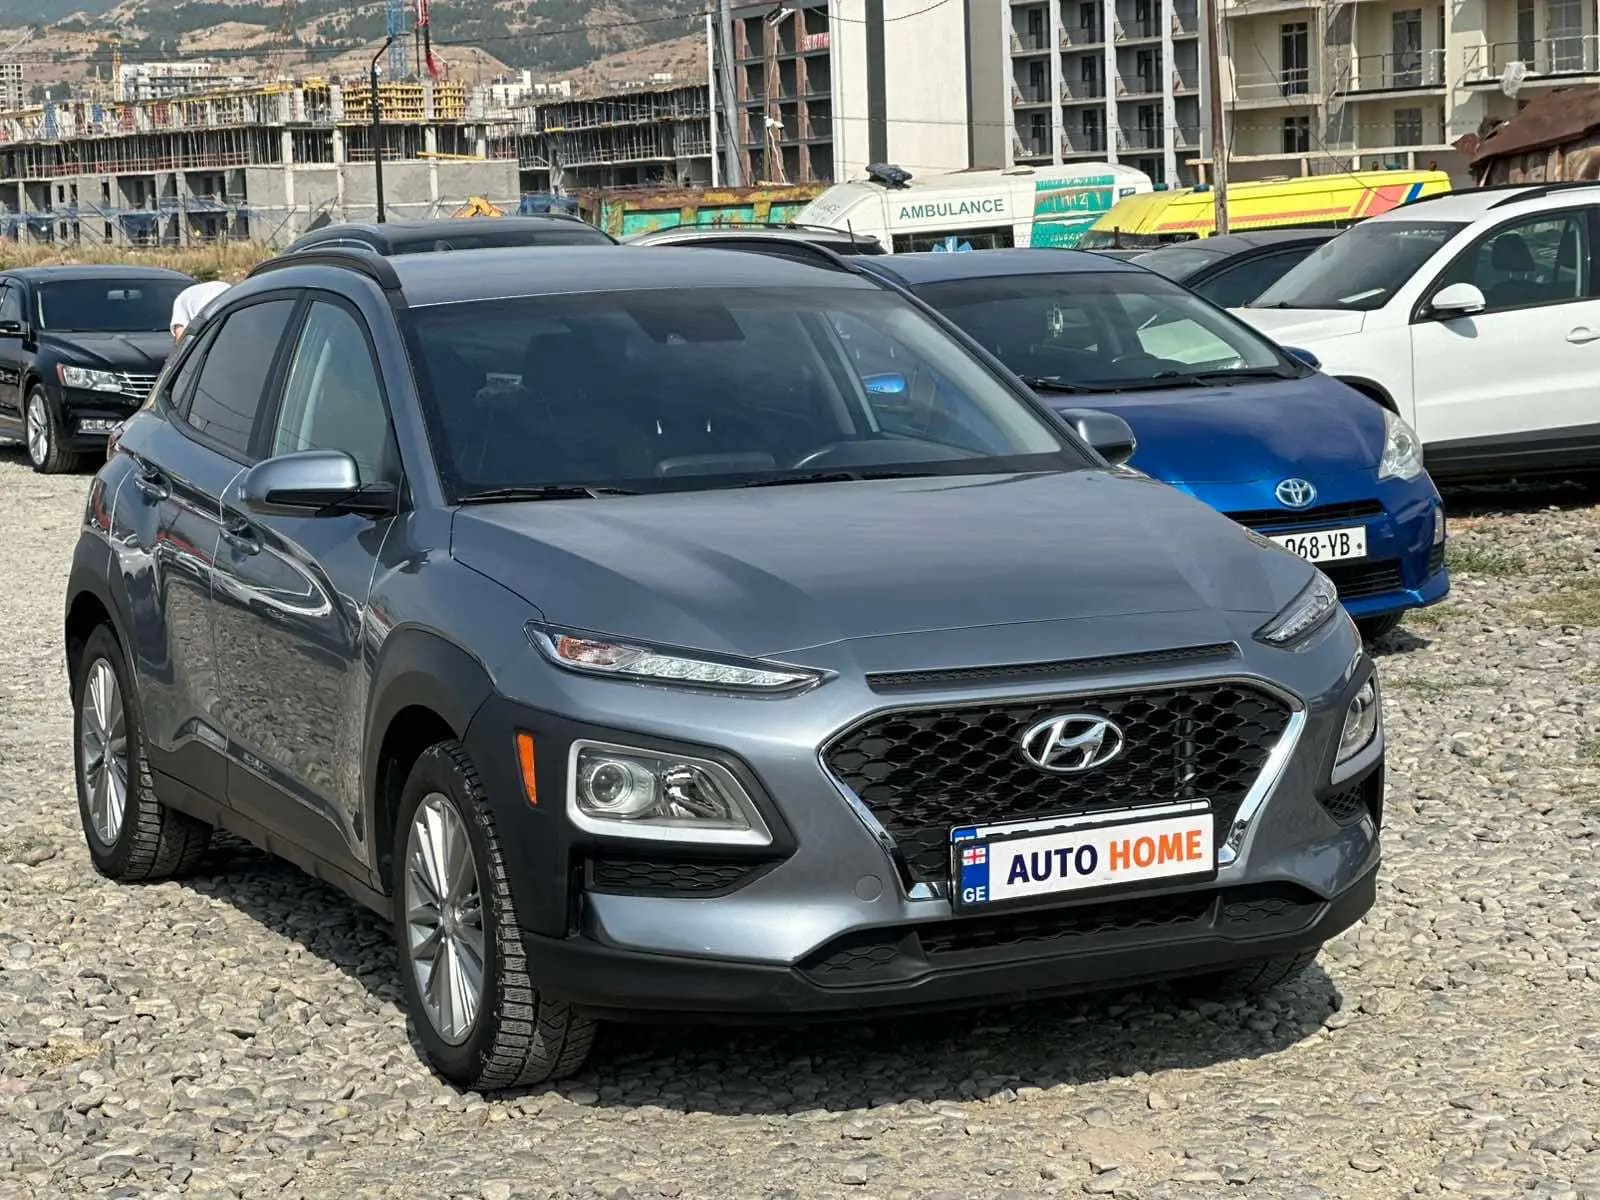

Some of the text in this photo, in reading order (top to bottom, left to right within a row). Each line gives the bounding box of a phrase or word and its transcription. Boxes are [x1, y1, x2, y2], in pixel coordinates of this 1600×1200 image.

[899, 198, 1005, 220] AMBULANCE
[1006, 829, 1203, 885] AUTO HOME
[962, 885, 986, 902] GE
